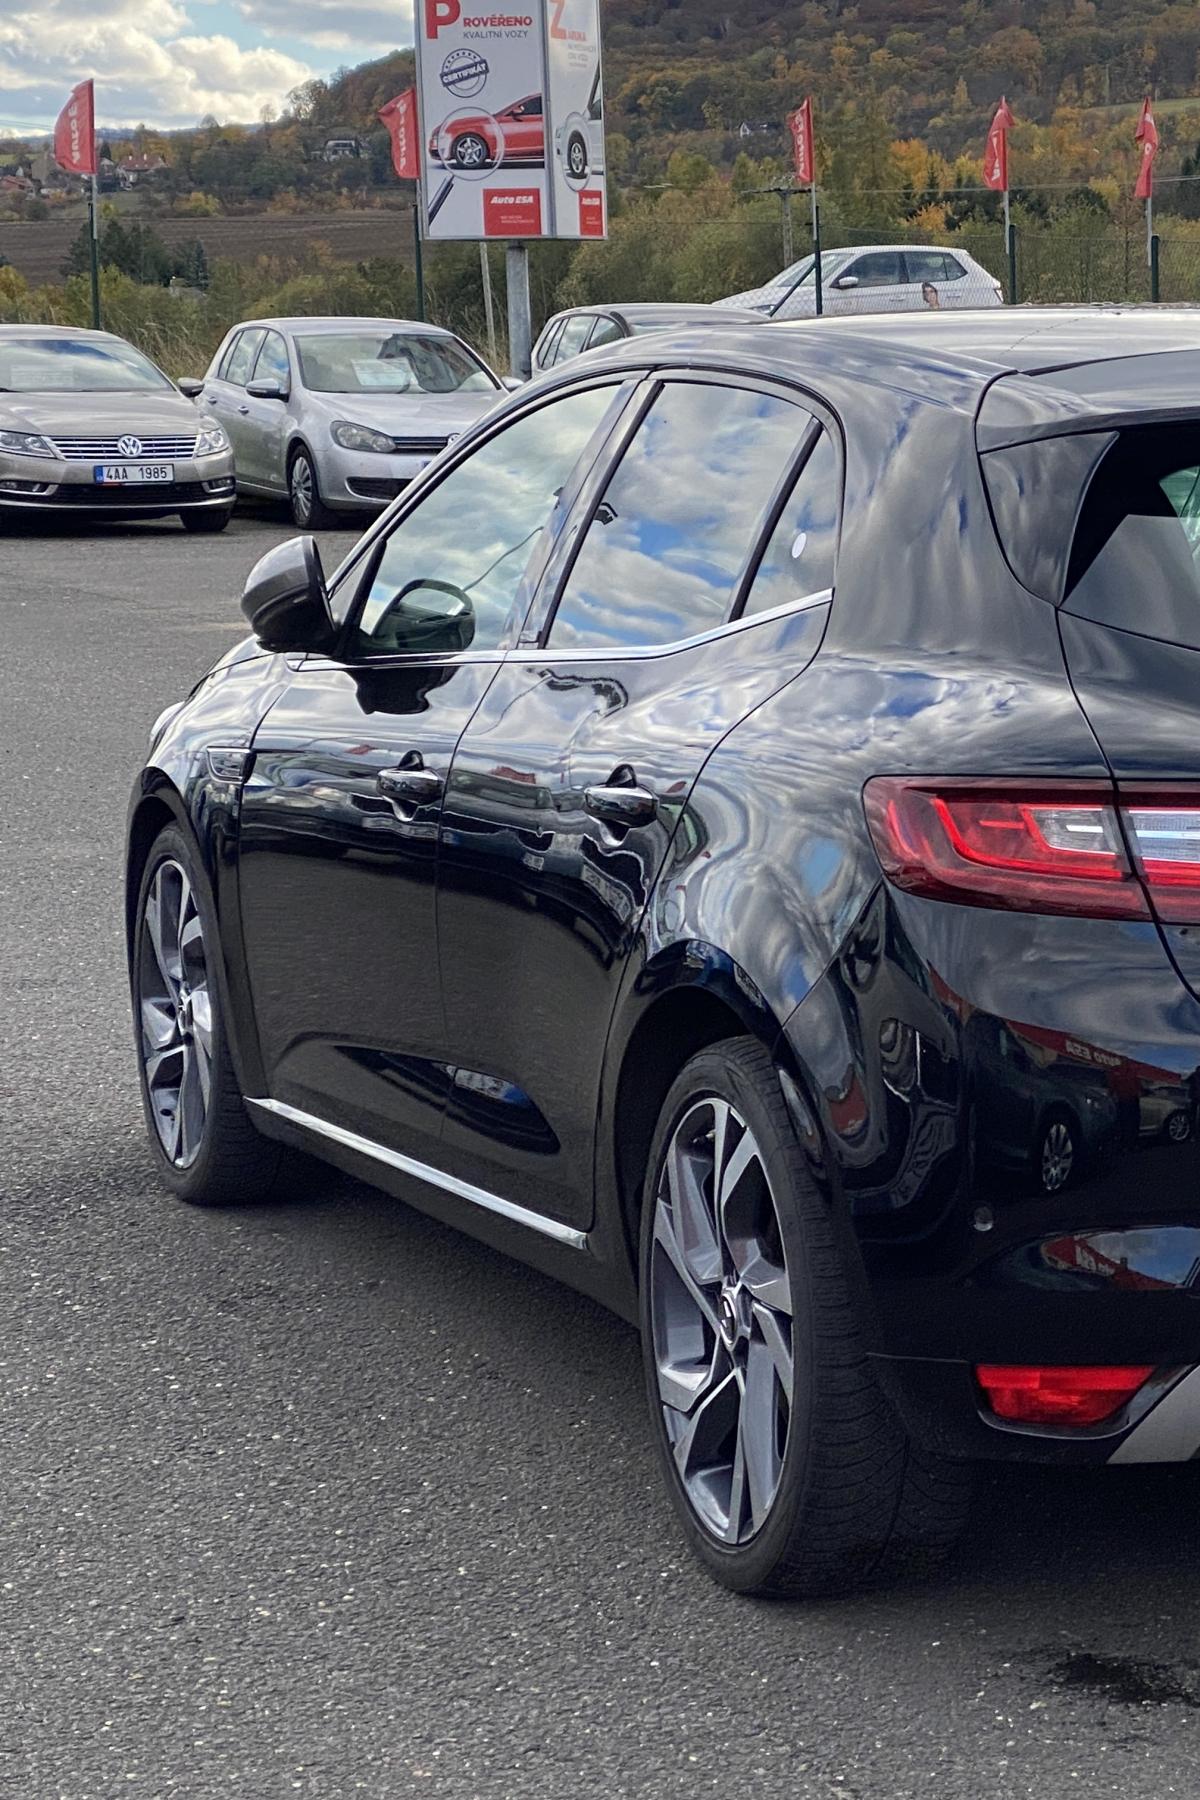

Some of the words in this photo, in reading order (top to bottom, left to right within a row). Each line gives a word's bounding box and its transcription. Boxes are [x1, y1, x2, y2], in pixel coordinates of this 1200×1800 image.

[463, 29, 502, 40] KVALITNÍ
[505, 30, 528, 39] VOZY
[490, 195, 514, 204] Auto
[515, 195, 534, 204] ESA
[106, 467, 128, 480] 4AA
[139, 466, 167, 480] 1985
